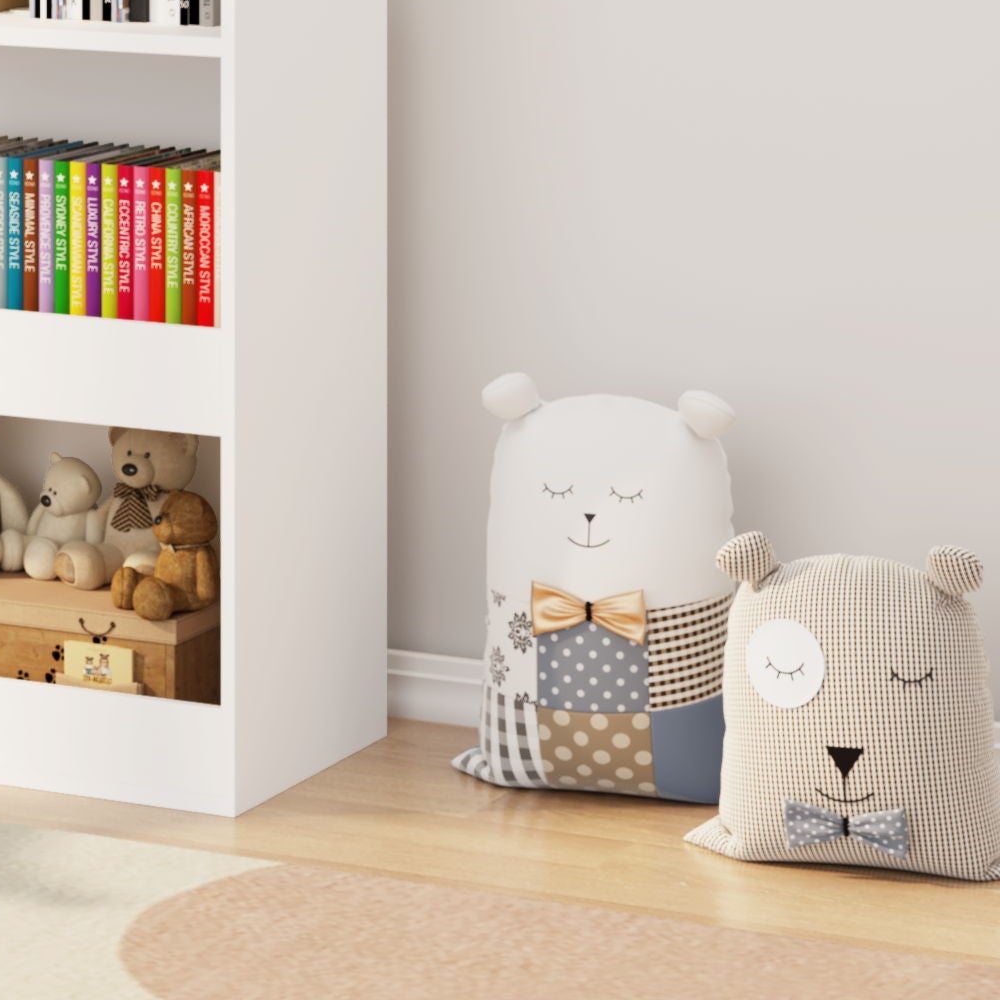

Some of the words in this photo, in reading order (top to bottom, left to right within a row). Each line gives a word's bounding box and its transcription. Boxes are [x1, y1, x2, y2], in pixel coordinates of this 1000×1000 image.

[9, 192, 19, 234] SEASIDE
[24, 193, 35, 236] MINIMAL
[40, 194, 51, 248] PROVENCE
[55, 195, 66, 236] SYDNEY
[87, 197, 98, 237] LUXURY
[103, 198, 114, 260] CALIFORNIA
[119, 200, 130, 258] ECCENTRIC
[135, 200, 146, 236] RETRO
[151, 202, 162, 235] CHINA
[167, 203, 178, 252] COUNTRY
[183, 204, 194, 250] AFRICAN
[72, 196, 82, 274] SCANDINAVIAN
[200, 205, 210, 268] MOROCCAN
[9, 237, 19, 269] STYLE
[24, 240, 35, 272] STYLE
[40, 250, 51, 284] STYLE
[56, 238, 66, 271] STYLE
[87, 240, 98, 272] STYLE
[135, 238, 146, 271] STYLE
[151, 237, 162, 270] STYLE
[183, 252, 194, 285] STYLE
[103, 263, 114, 295] STYLE
[119, 260, 130, 292] STYLE
[167, 254, 178, 288] STYLE
[200, 270, 210, 303] STYLE
[72, 276, 82, 307] STYLE
